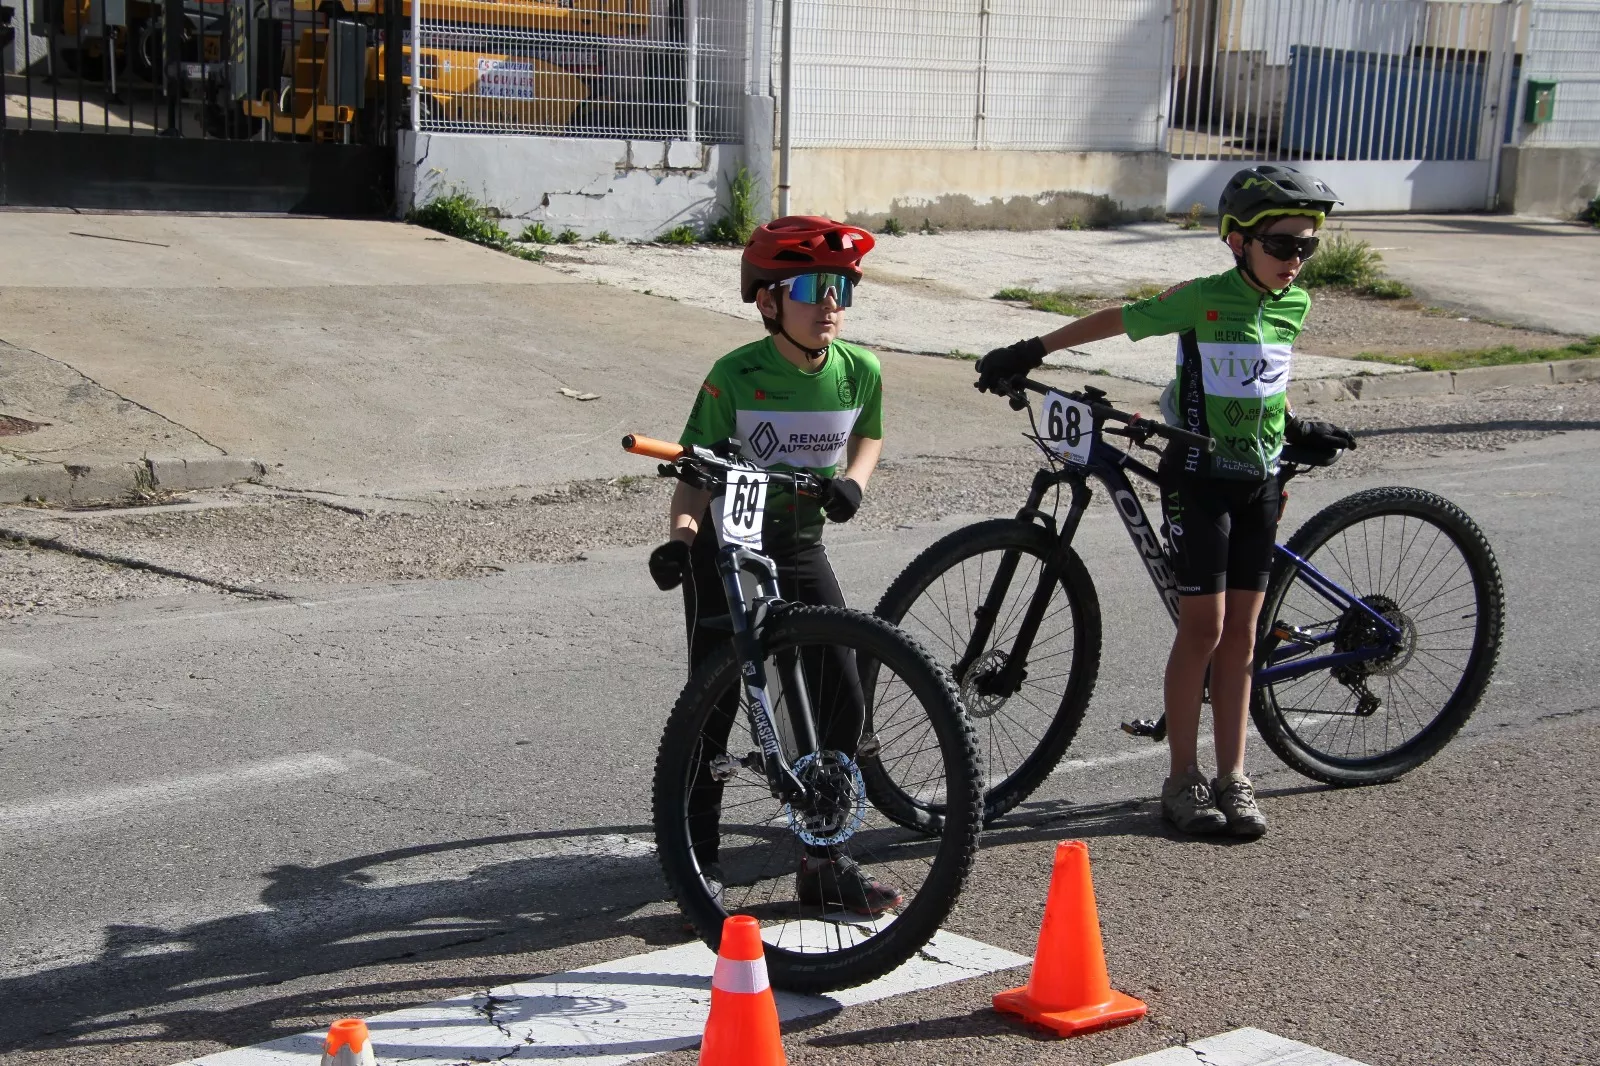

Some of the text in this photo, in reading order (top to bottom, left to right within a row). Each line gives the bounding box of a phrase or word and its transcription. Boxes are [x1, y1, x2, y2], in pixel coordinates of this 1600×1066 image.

[778, 439, 847, 453] AUTO CUATRO
[789, 431, 846, 444] RENAULT
[1048, 399, 1081, 448] 68
[731, 473, 760, 530] 69
[1115, 489, 1180, 620] ORBE
[1486, 580, 1499, 649] KENDA
[750, 701, 780, 757] ROCKSHOX
